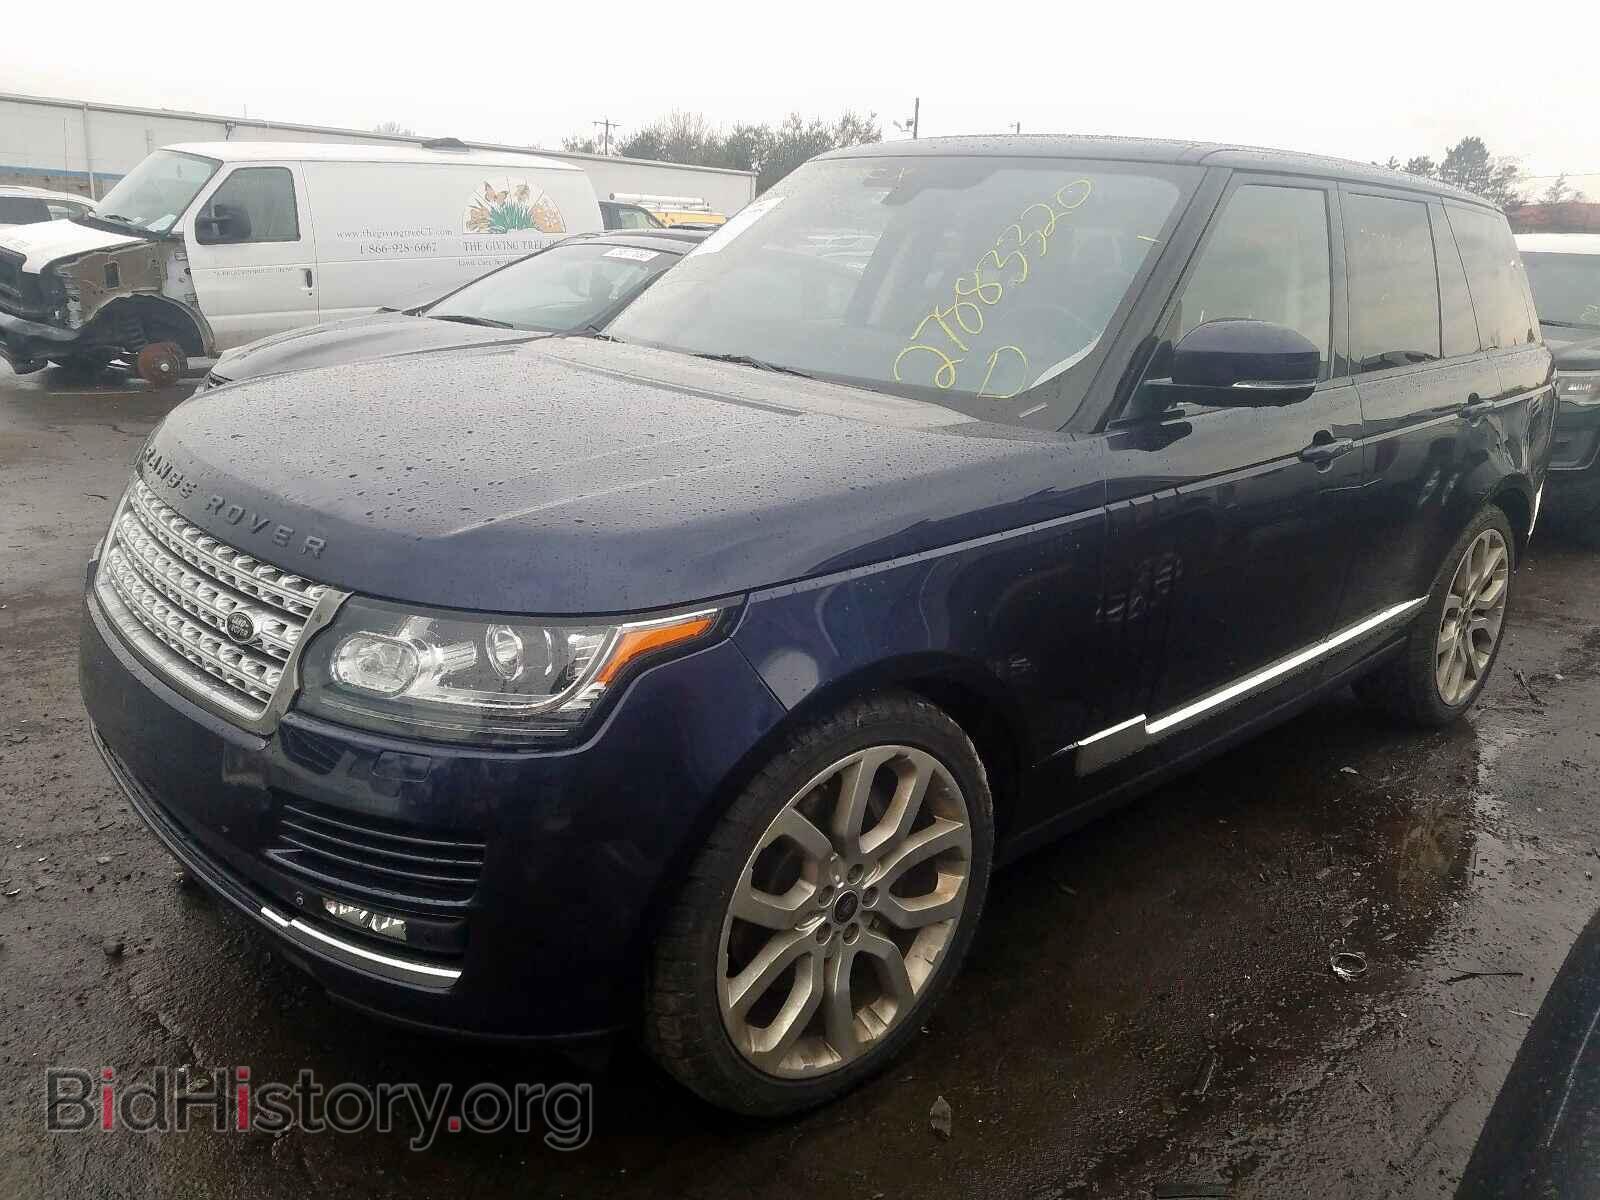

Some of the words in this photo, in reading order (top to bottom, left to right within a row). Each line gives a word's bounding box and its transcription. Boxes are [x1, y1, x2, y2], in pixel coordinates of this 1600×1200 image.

[463, 241, 480, 252] THE
[485, 239, 518, 251] GIVING
[142, 447, 198, 500] RANGE
[205, 494, 327, 560] ROVER
